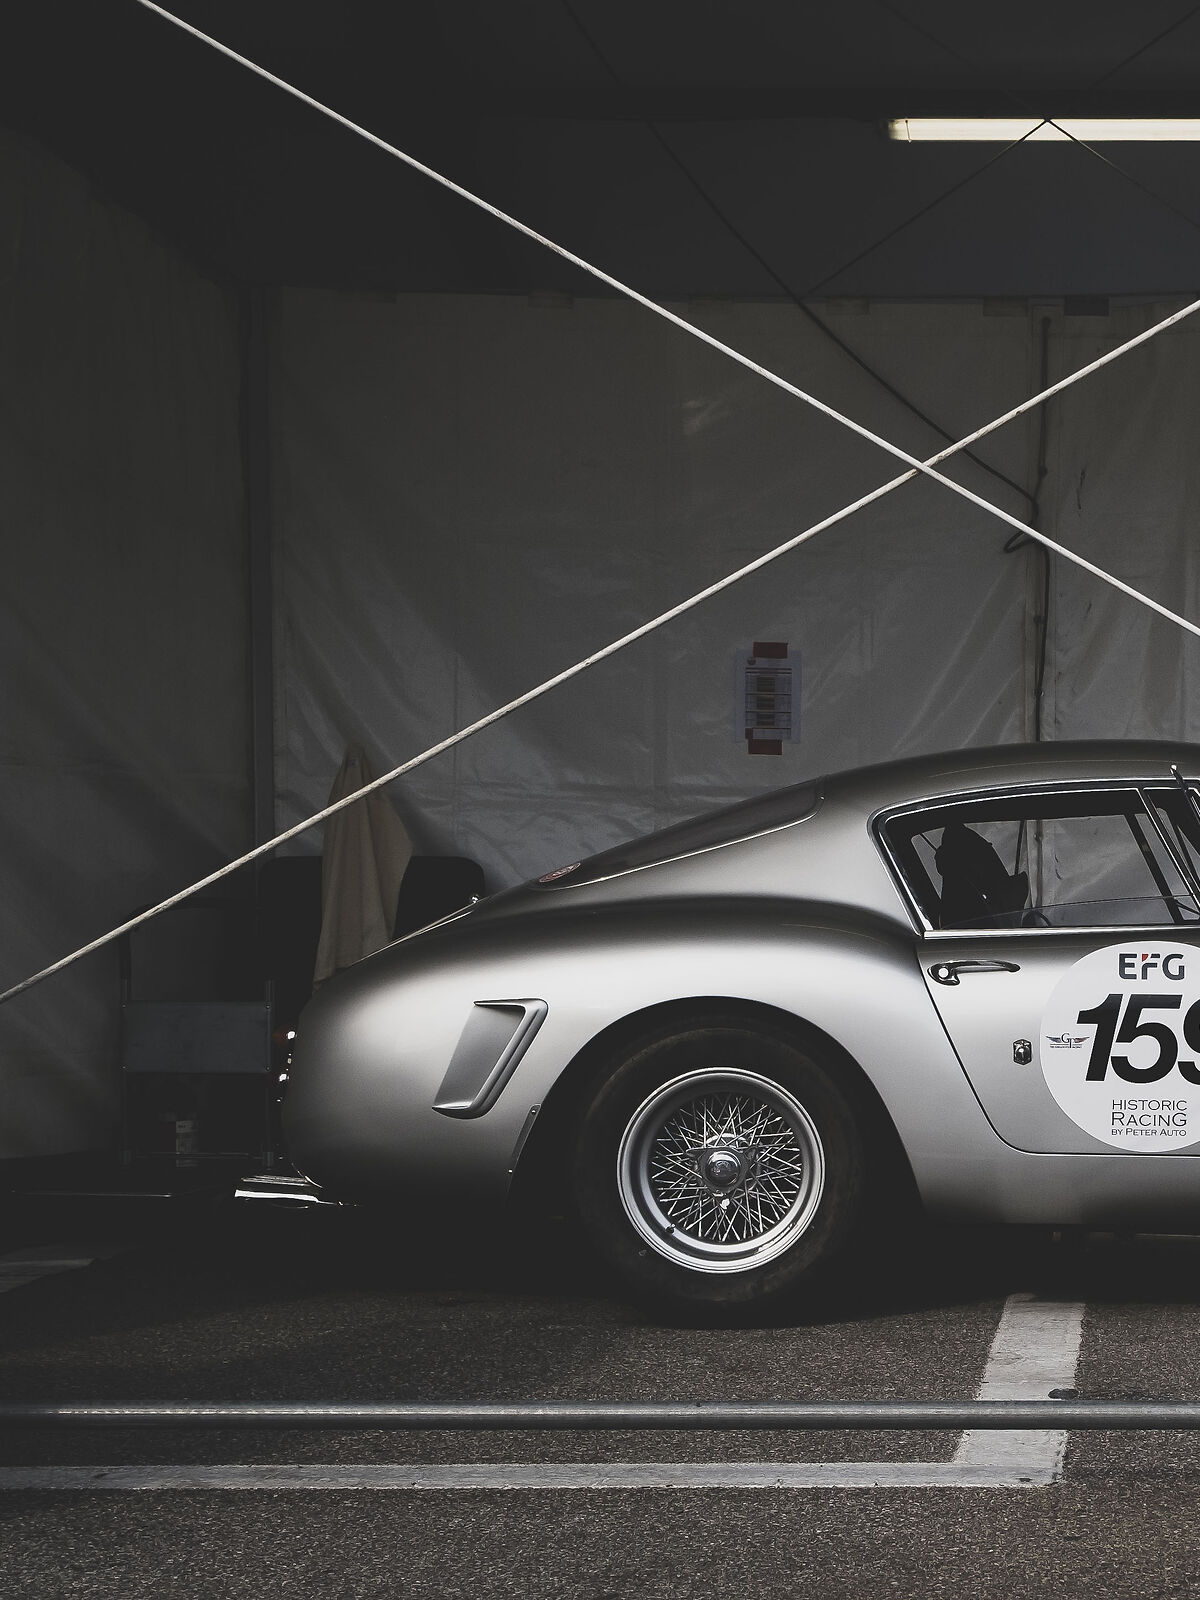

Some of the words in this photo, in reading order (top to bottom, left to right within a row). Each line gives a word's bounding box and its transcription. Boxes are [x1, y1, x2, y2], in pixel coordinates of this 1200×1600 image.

[1118, 953, 1185, 980] EFG
[1112, 1099, 1188, 1111] HISTORIC
[1111, 1111, 1187, 1127] RACING
[1111, 1128, 1123, 1136] BY
[1125, 1127, 1158, 1137] PETER
[1159, 1128, 1187, 1137] AUTO
